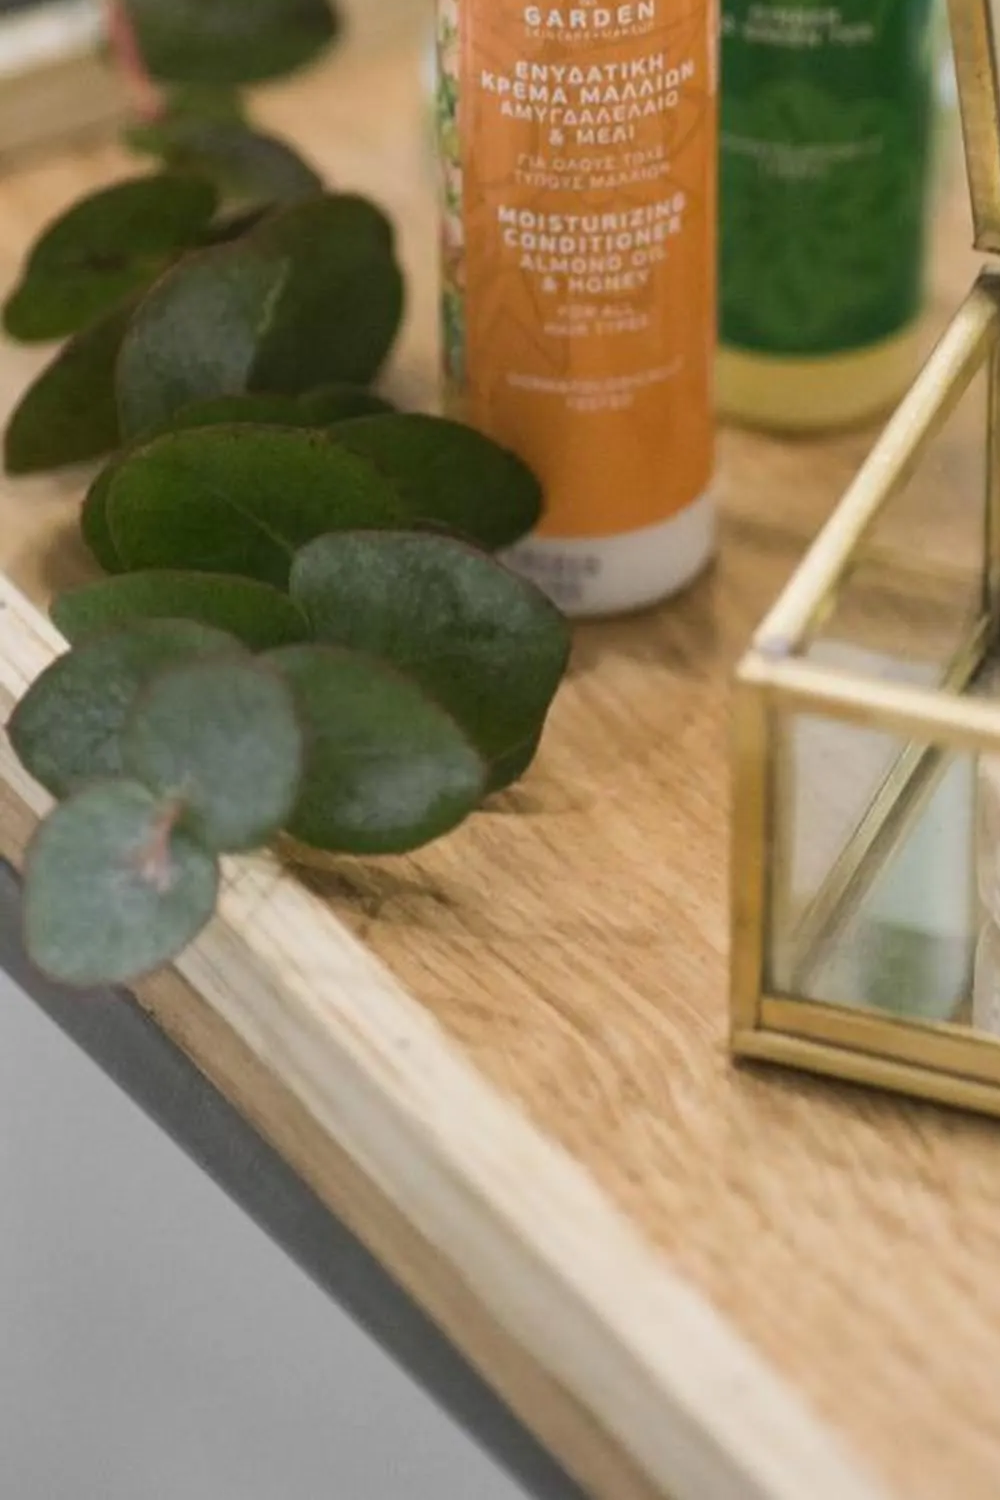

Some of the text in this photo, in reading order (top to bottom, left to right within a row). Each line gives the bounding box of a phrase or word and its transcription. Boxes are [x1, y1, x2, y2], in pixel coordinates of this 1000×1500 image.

[480, 59, 695, 107] ΚΡΕΜΑ ΜΑΛΛΙΩΝ
[514, 53, 665, 86] ΕΝΥΔΑΤΙΚΗ
[497, 191, 687, 234] MOISTURIZING
[502, 214, 682, 256] CONDITIONER
[519, 252, 623, 276] ALMOND
[567, 268, 650, 294] HONEY
